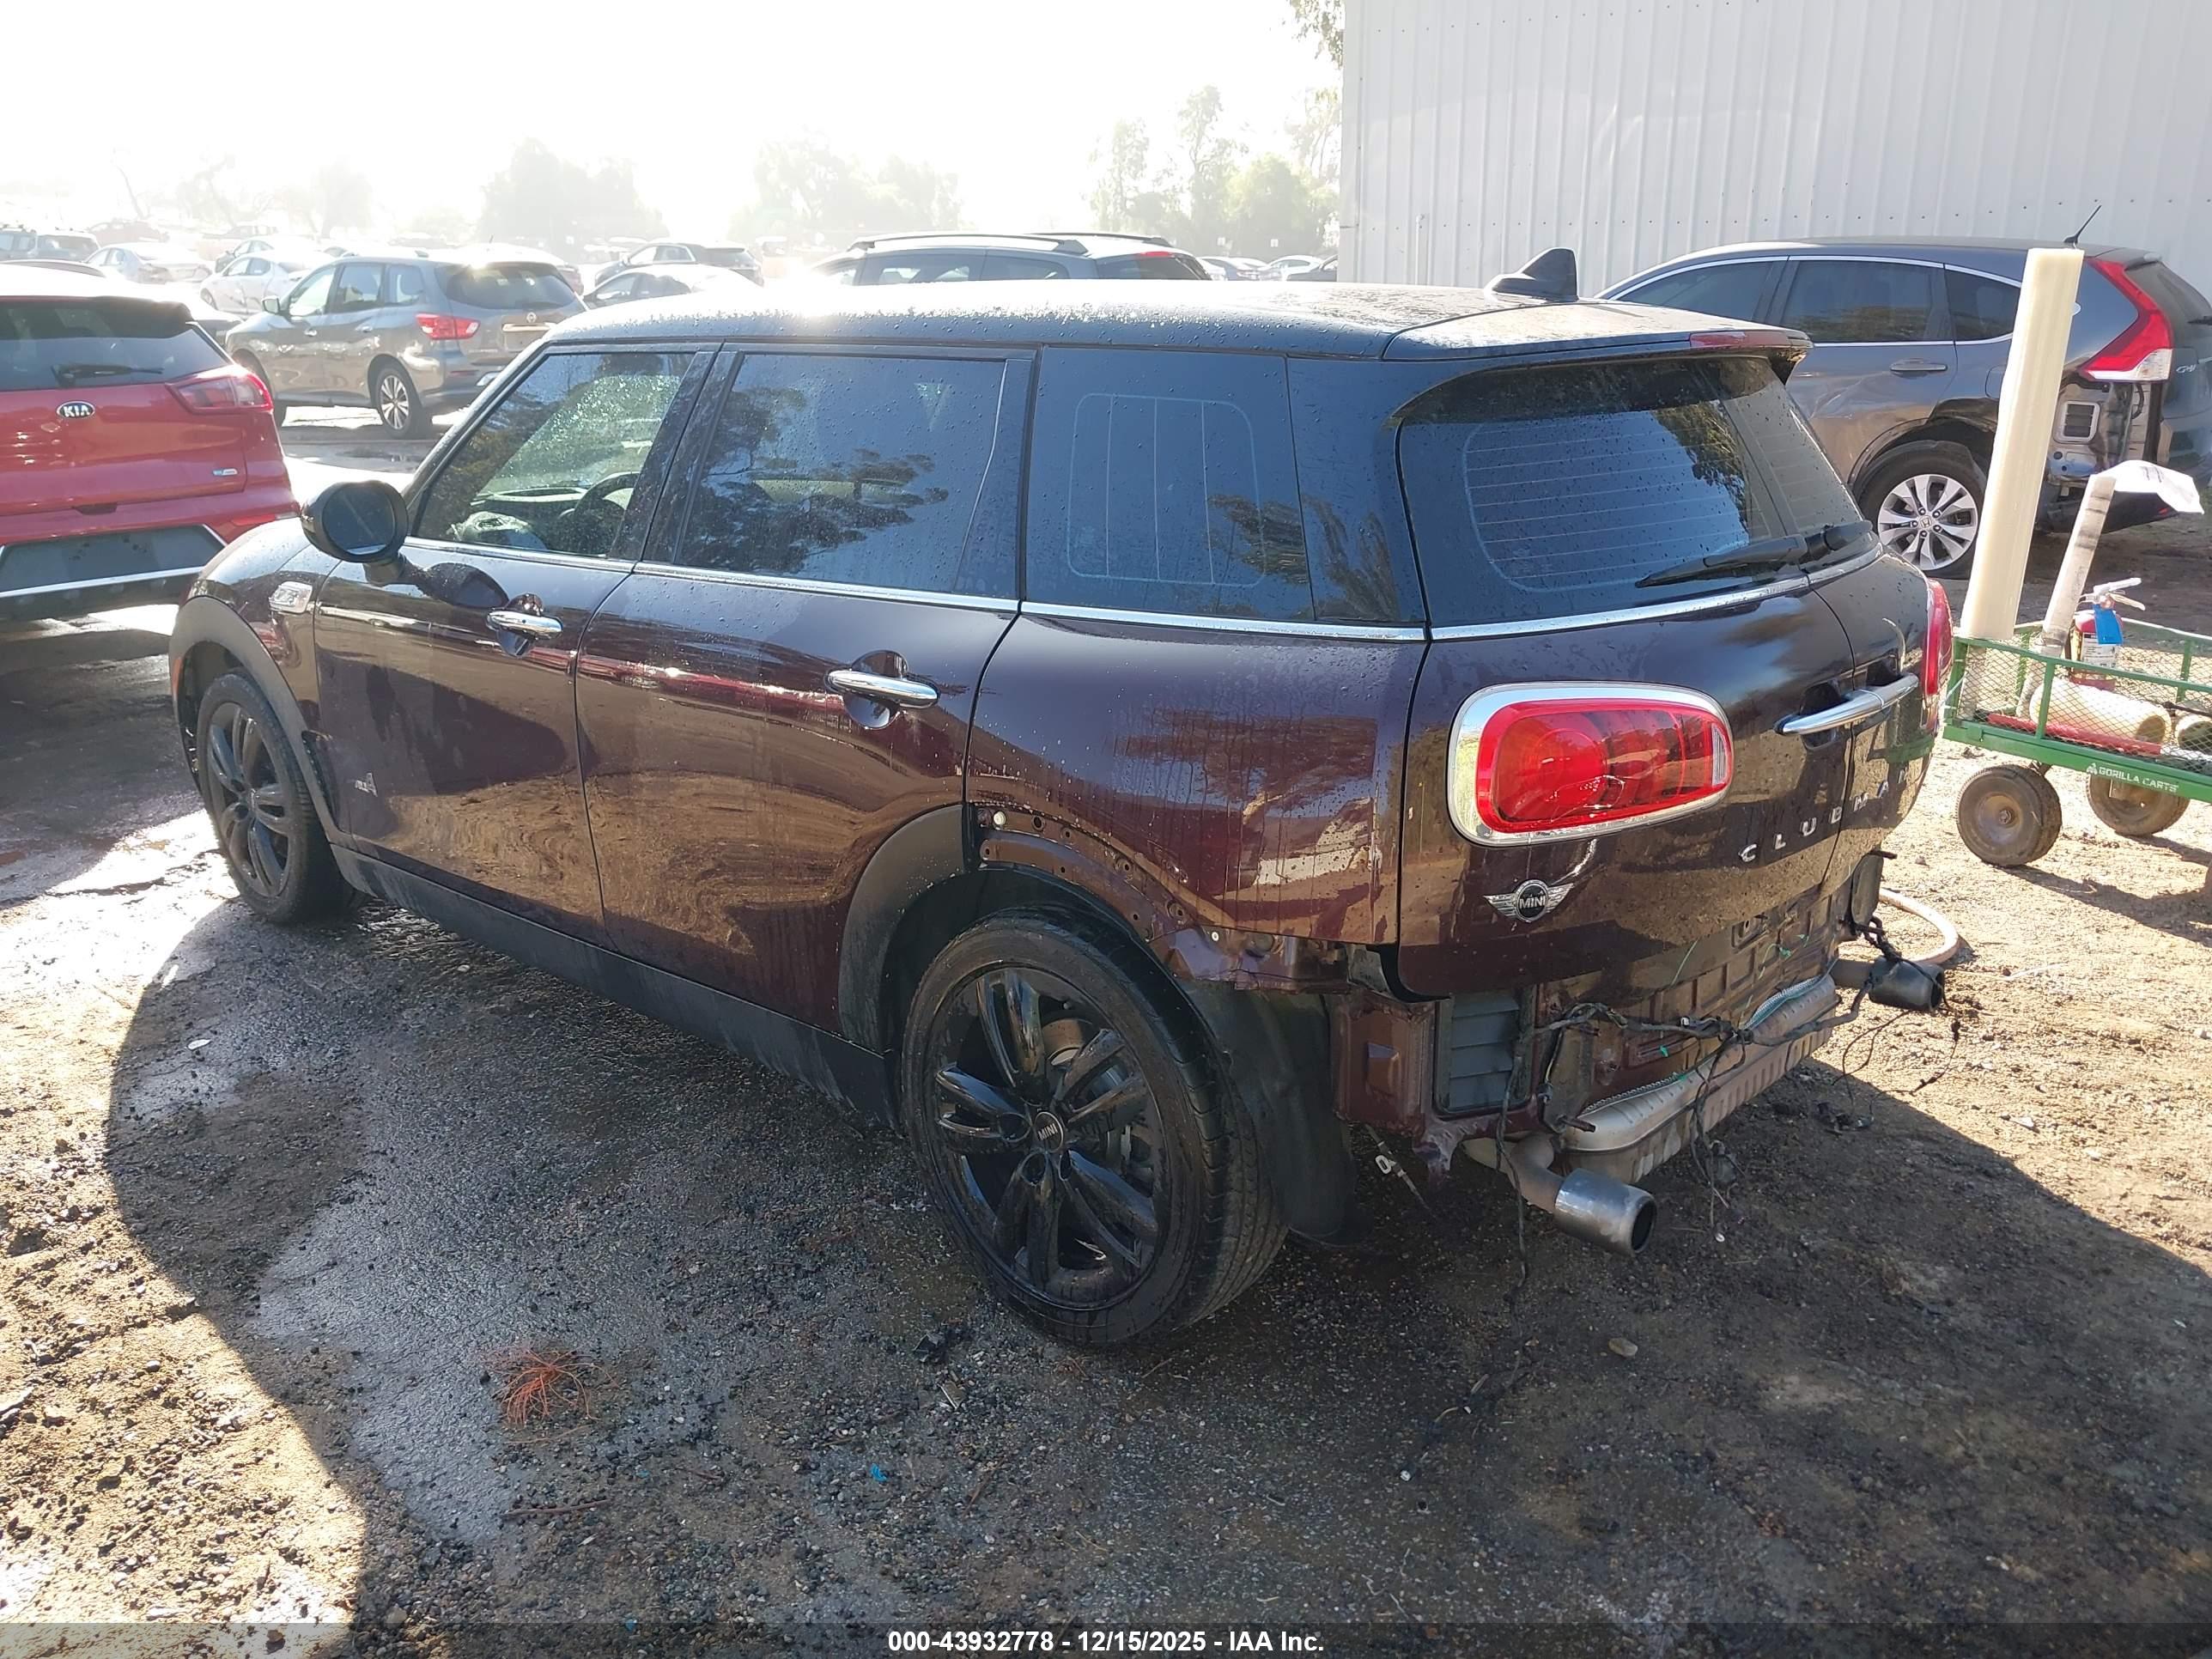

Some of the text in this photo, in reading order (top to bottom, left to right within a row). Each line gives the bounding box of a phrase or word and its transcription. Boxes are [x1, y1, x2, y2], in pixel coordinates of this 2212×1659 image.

[63, 404, 90, 417] KIA
[2099, 766, 2179, 793] GORILLA CARTS
[1738, 768, 1908, 863] CLUBMAN
[1519, 895, 1546, 909] MINI
[1037, 1122, 1058, 1141] MINI
